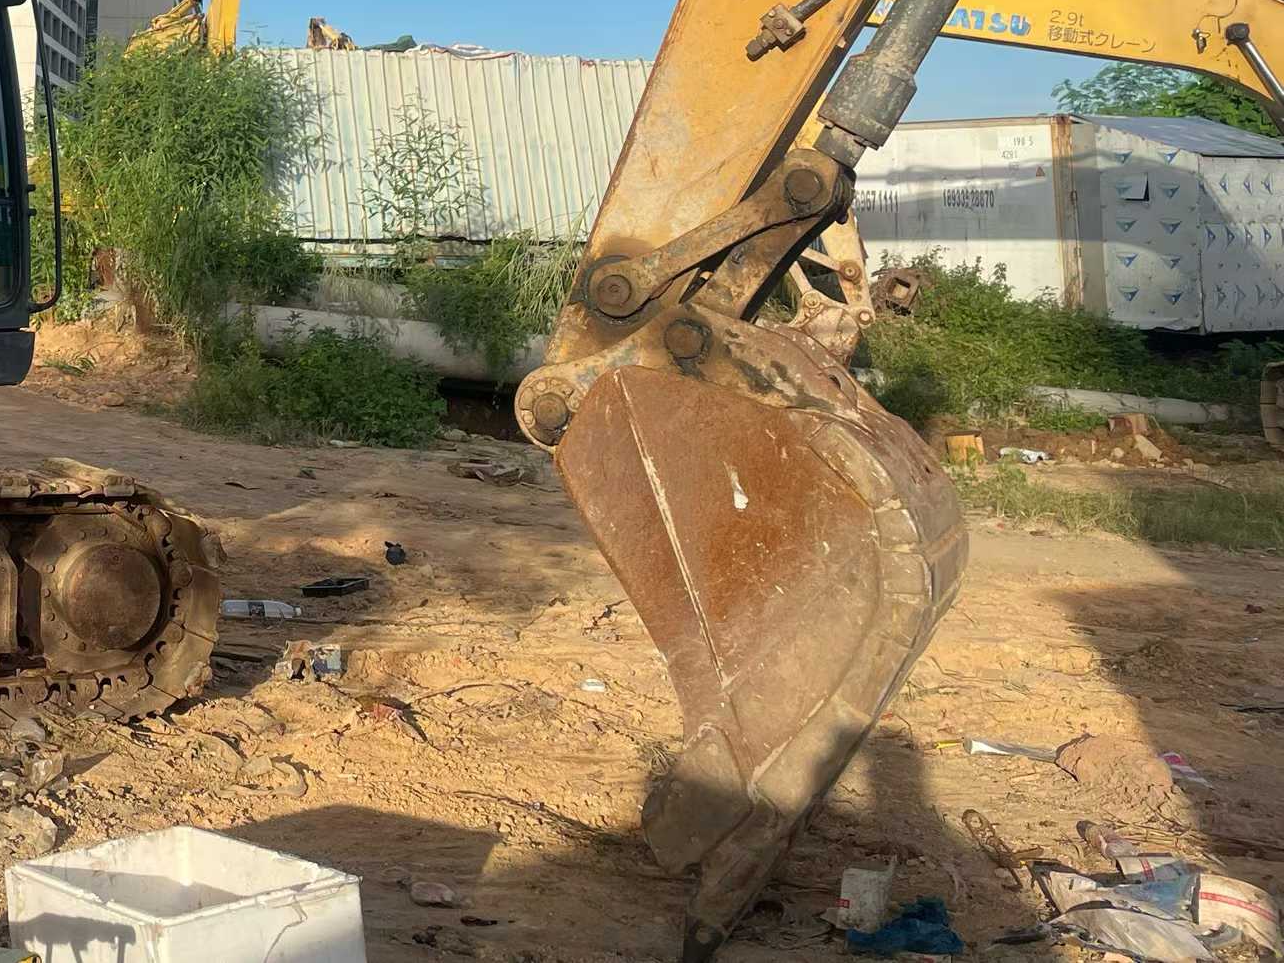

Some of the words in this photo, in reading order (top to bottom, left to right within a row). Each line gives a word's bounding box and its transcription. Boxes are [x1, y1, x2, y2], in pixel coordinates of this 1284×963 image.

[1049, 9, 1084, 27] 2.9t
[1048, 25, 1156, 53] 移動式クレーン
